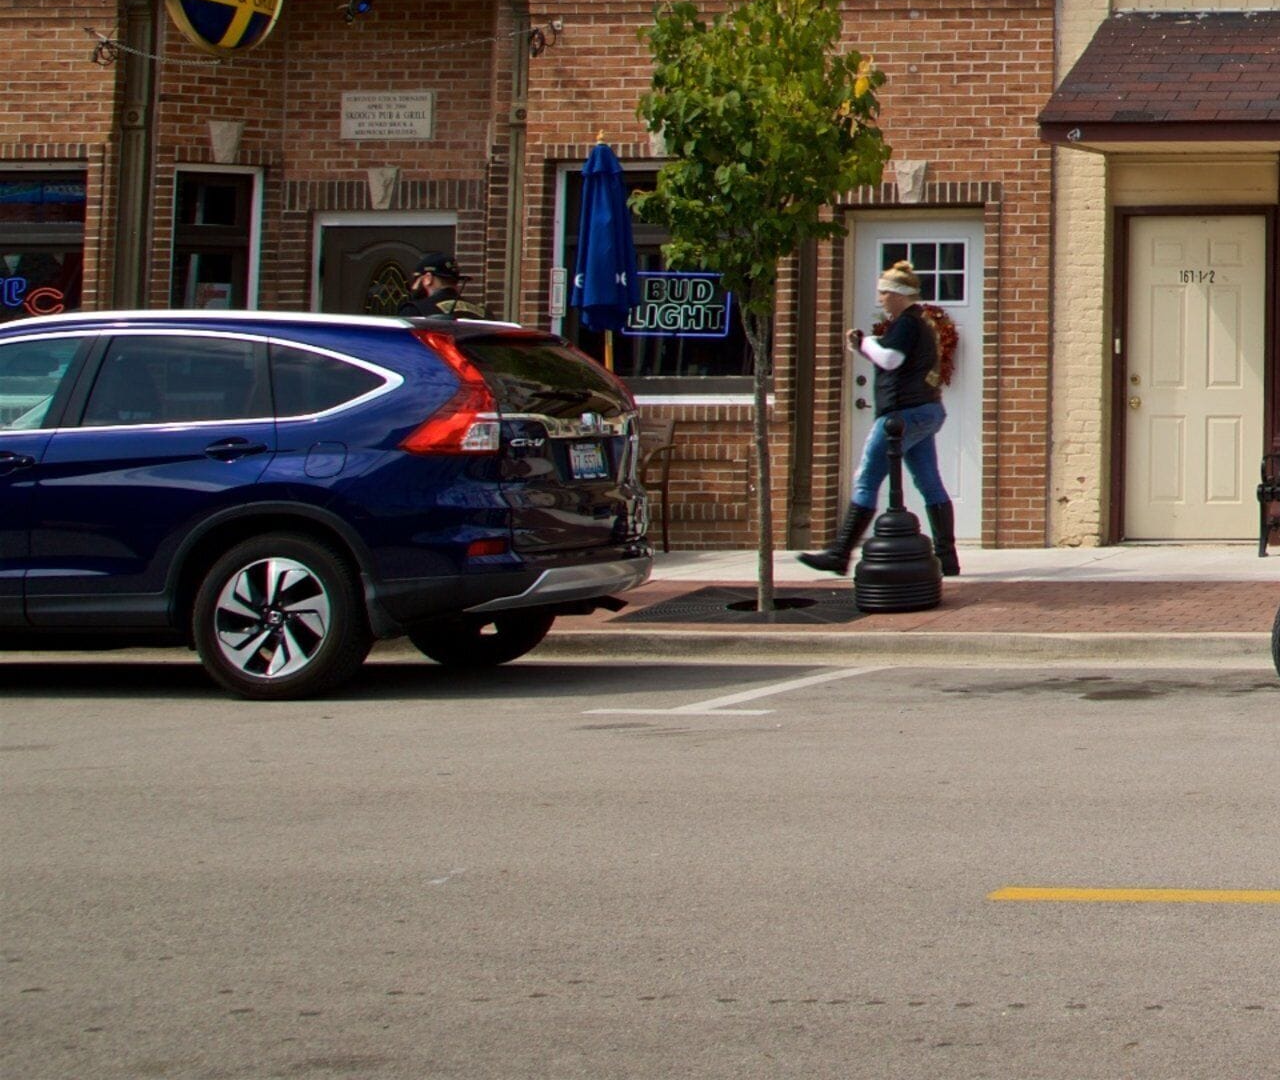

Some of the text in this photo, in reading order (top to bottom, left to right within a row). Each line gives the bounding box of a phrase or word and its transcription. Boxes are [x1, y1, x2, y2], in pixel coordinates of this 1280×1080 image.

[378, 111, 394, 120] PUB
[644, 278, 714, 304] BUD
[628, 303, 726, 330] LIGHT
